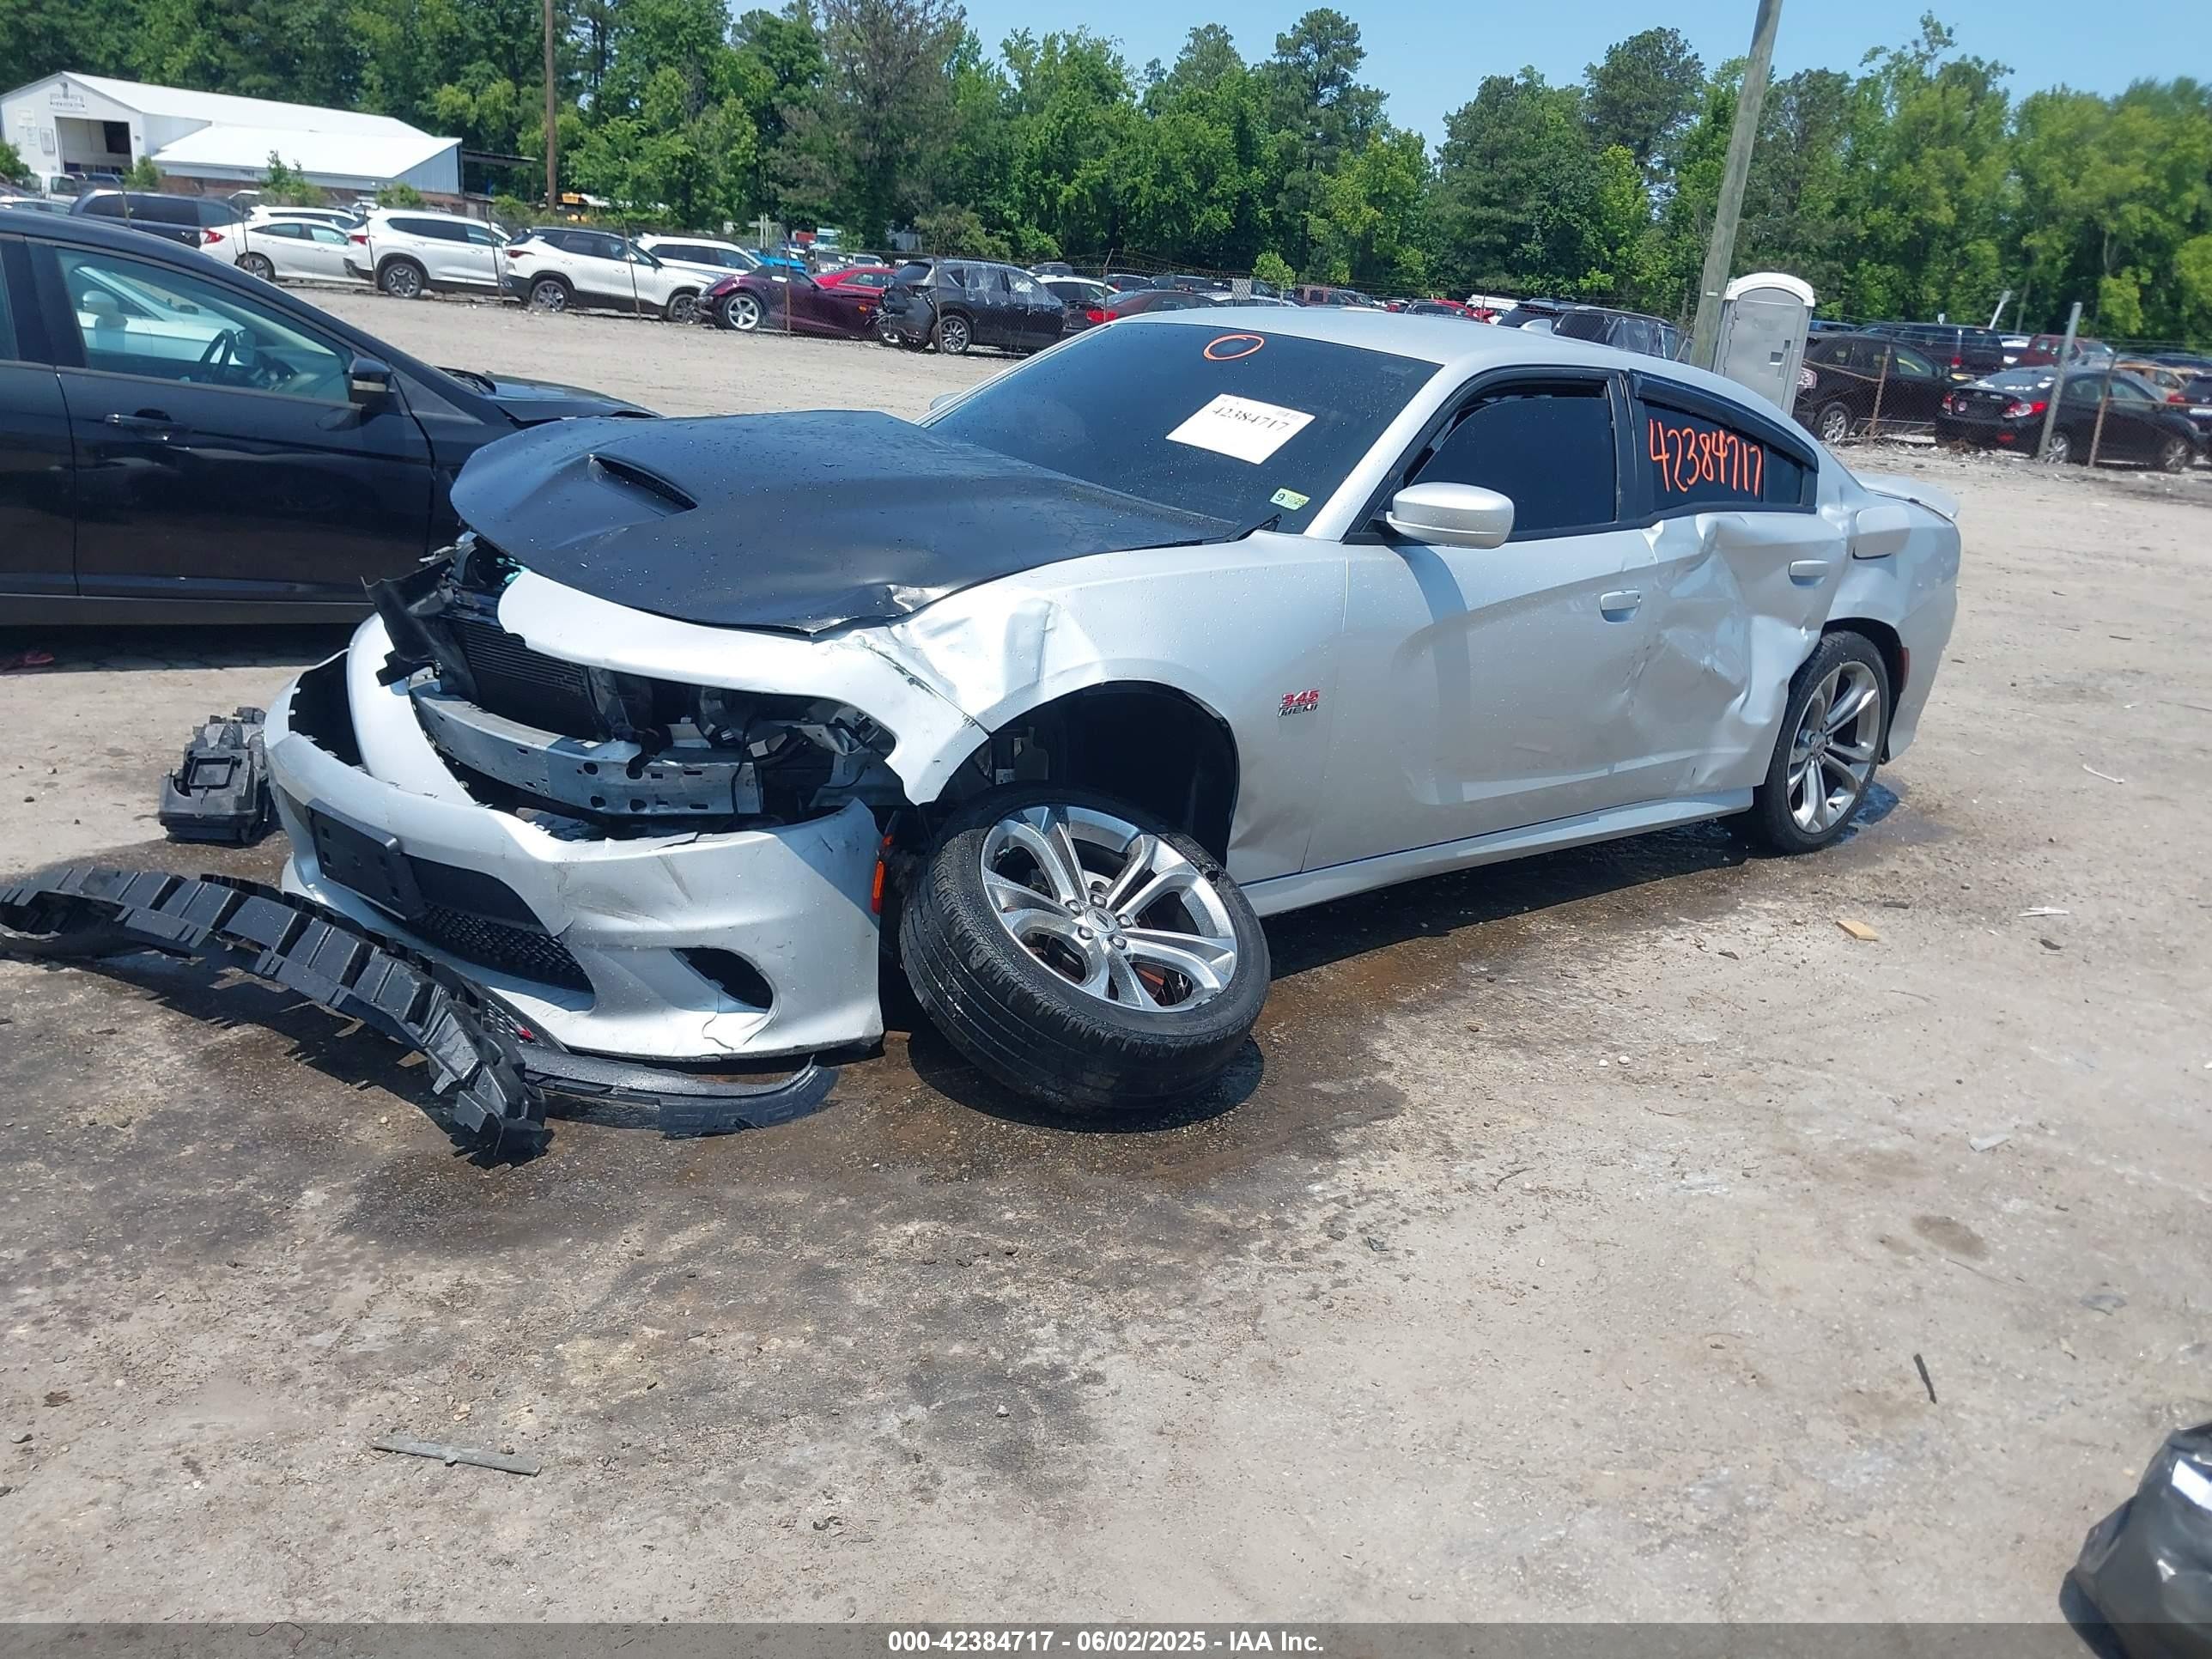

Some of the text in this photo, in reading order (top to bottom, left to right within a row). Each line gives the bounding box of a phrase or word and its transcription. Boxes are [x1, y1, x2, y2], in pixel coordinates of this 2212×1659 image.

[1212, 407, 1290, 432] 42384717
[1649, 417, 1763, 497] 42384717
[1276, 492, 1285, 501] 9
[1282, 689, 1320, 708] 345
[1278, 703, 1318, 717] HEMI
